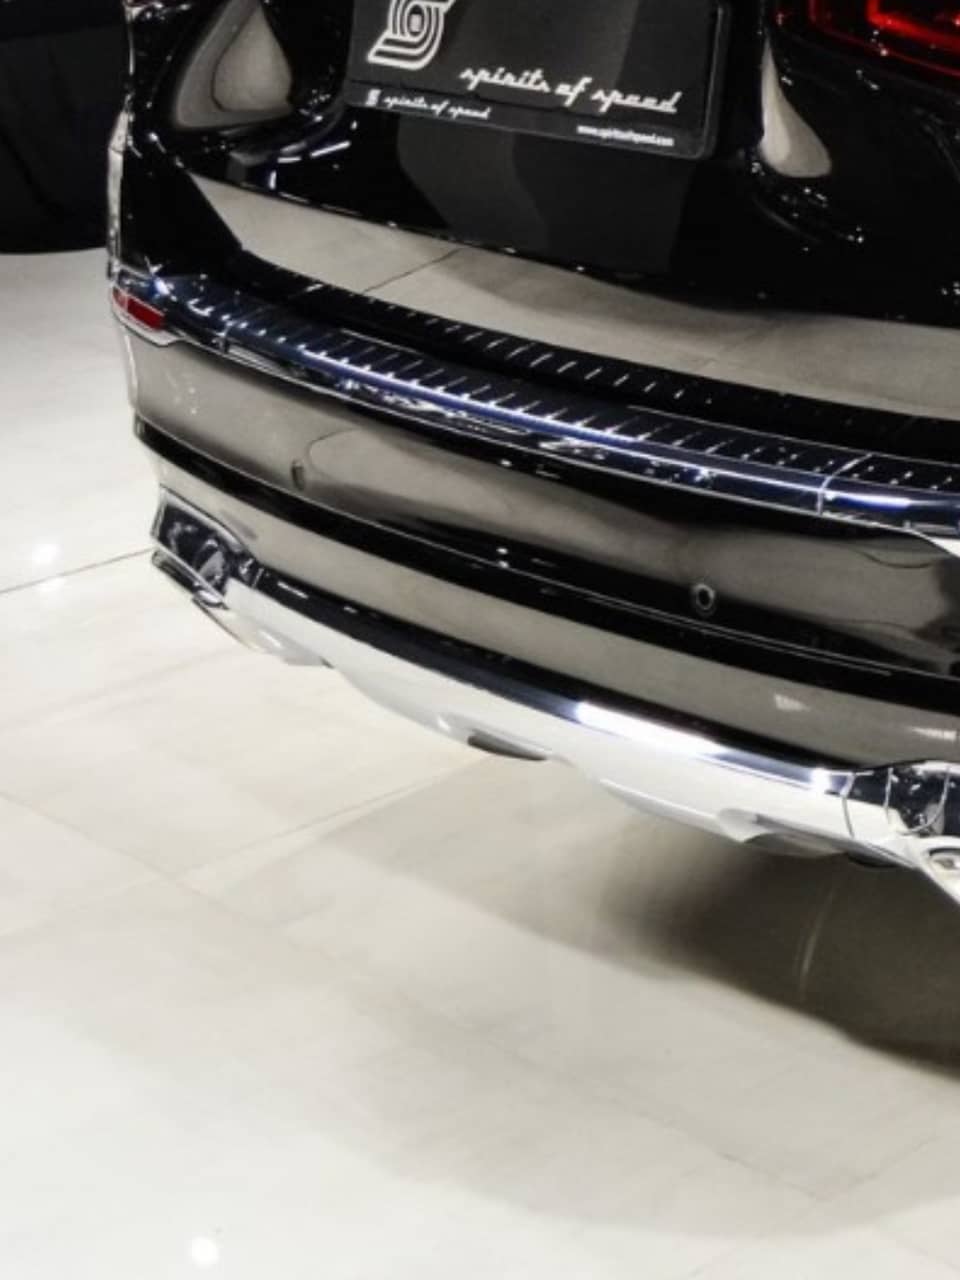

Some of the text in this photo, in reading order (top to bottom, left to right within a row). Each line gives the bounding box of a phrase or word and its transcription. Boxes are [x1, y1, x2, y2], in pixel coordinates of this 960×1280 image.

[460, 67, 682, 112] spirits of speed
